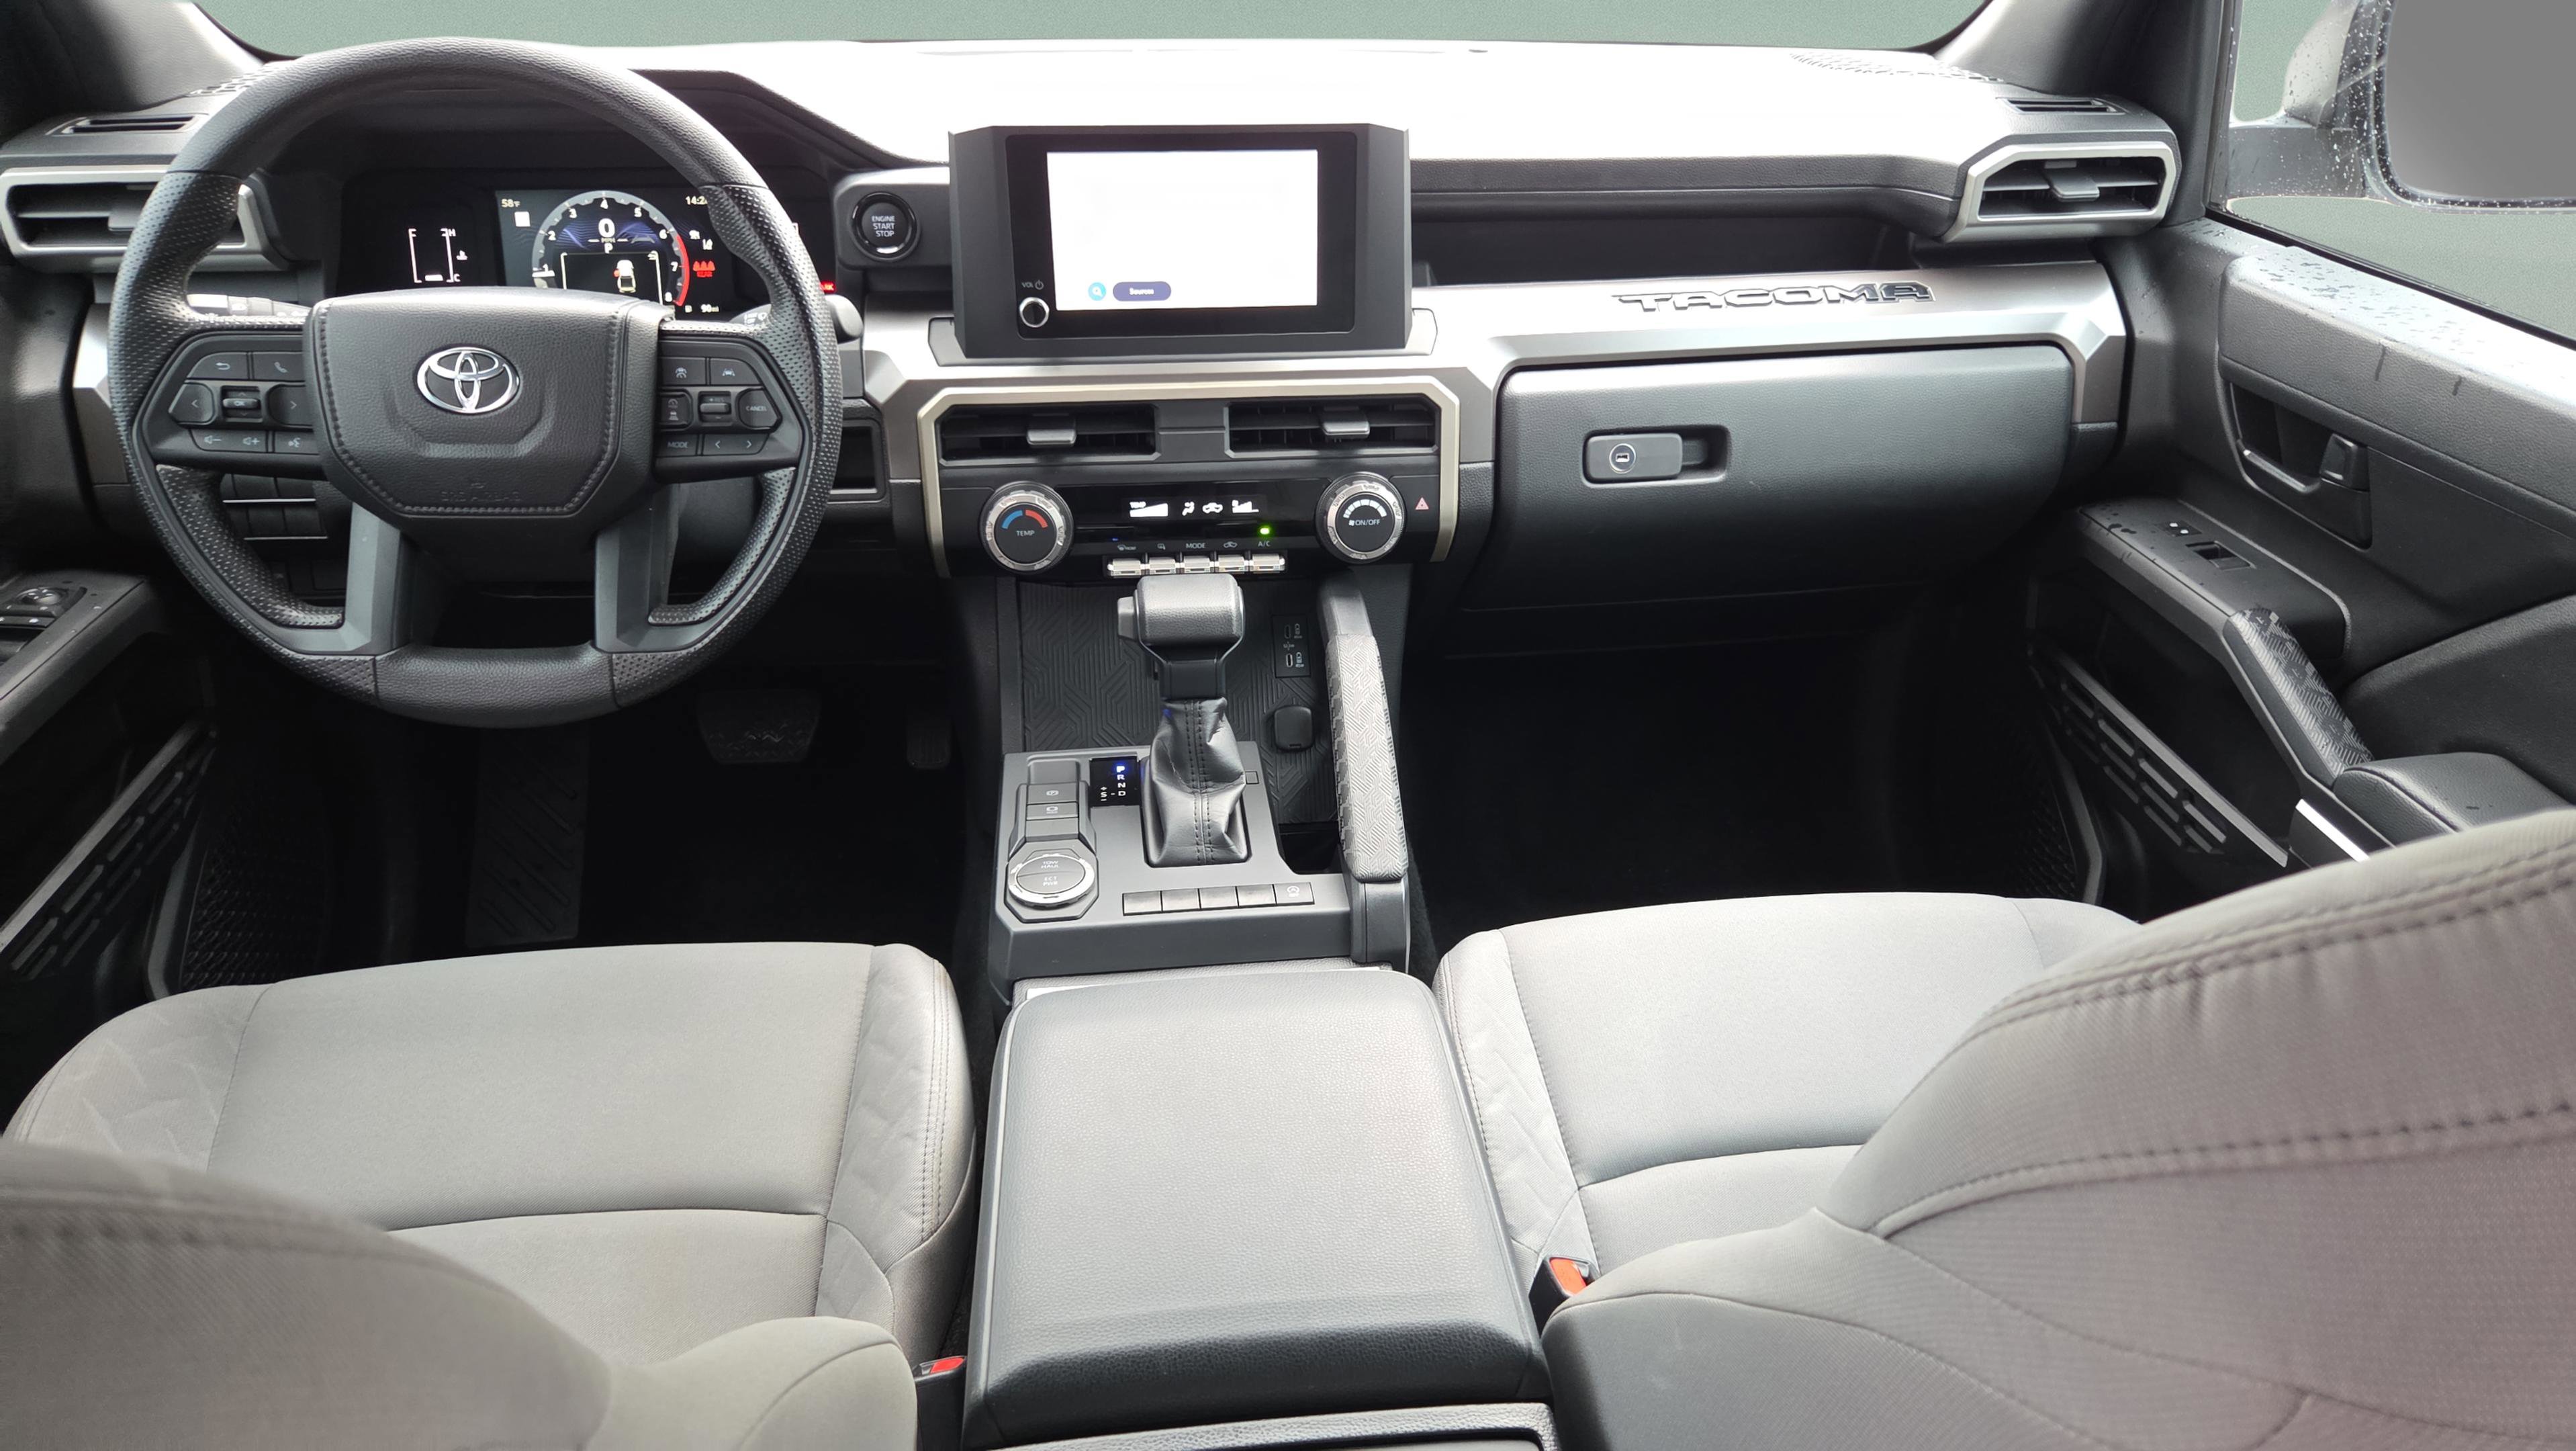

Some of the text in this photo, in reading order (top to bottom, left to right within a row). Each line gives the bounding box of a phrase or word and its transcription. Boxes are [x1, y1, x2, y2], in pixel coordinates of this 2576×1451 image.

[569, 208, 578, 218] 3
[634, 207, 642, 218] 5
[598, 218, 615, 238] 0
[873, 222, 895, 230] START
[448, 228, 457, 236] H
[547, 230, 557, 241] 2
[604, 242, 614, 254] P
[670, 261, 678, 272] 7
[454, 273, 461, 282] C
[1612, 281, 1935, 312] TACOMA
[668, 441, 688, 449] MODE
[1354, 519, 1381, 527] ON/OFF
[1015, 529, 1036, 537] TEMP
[1257, 540, 1271, 548] A/C
[1116, 765, 1125, 773] P
